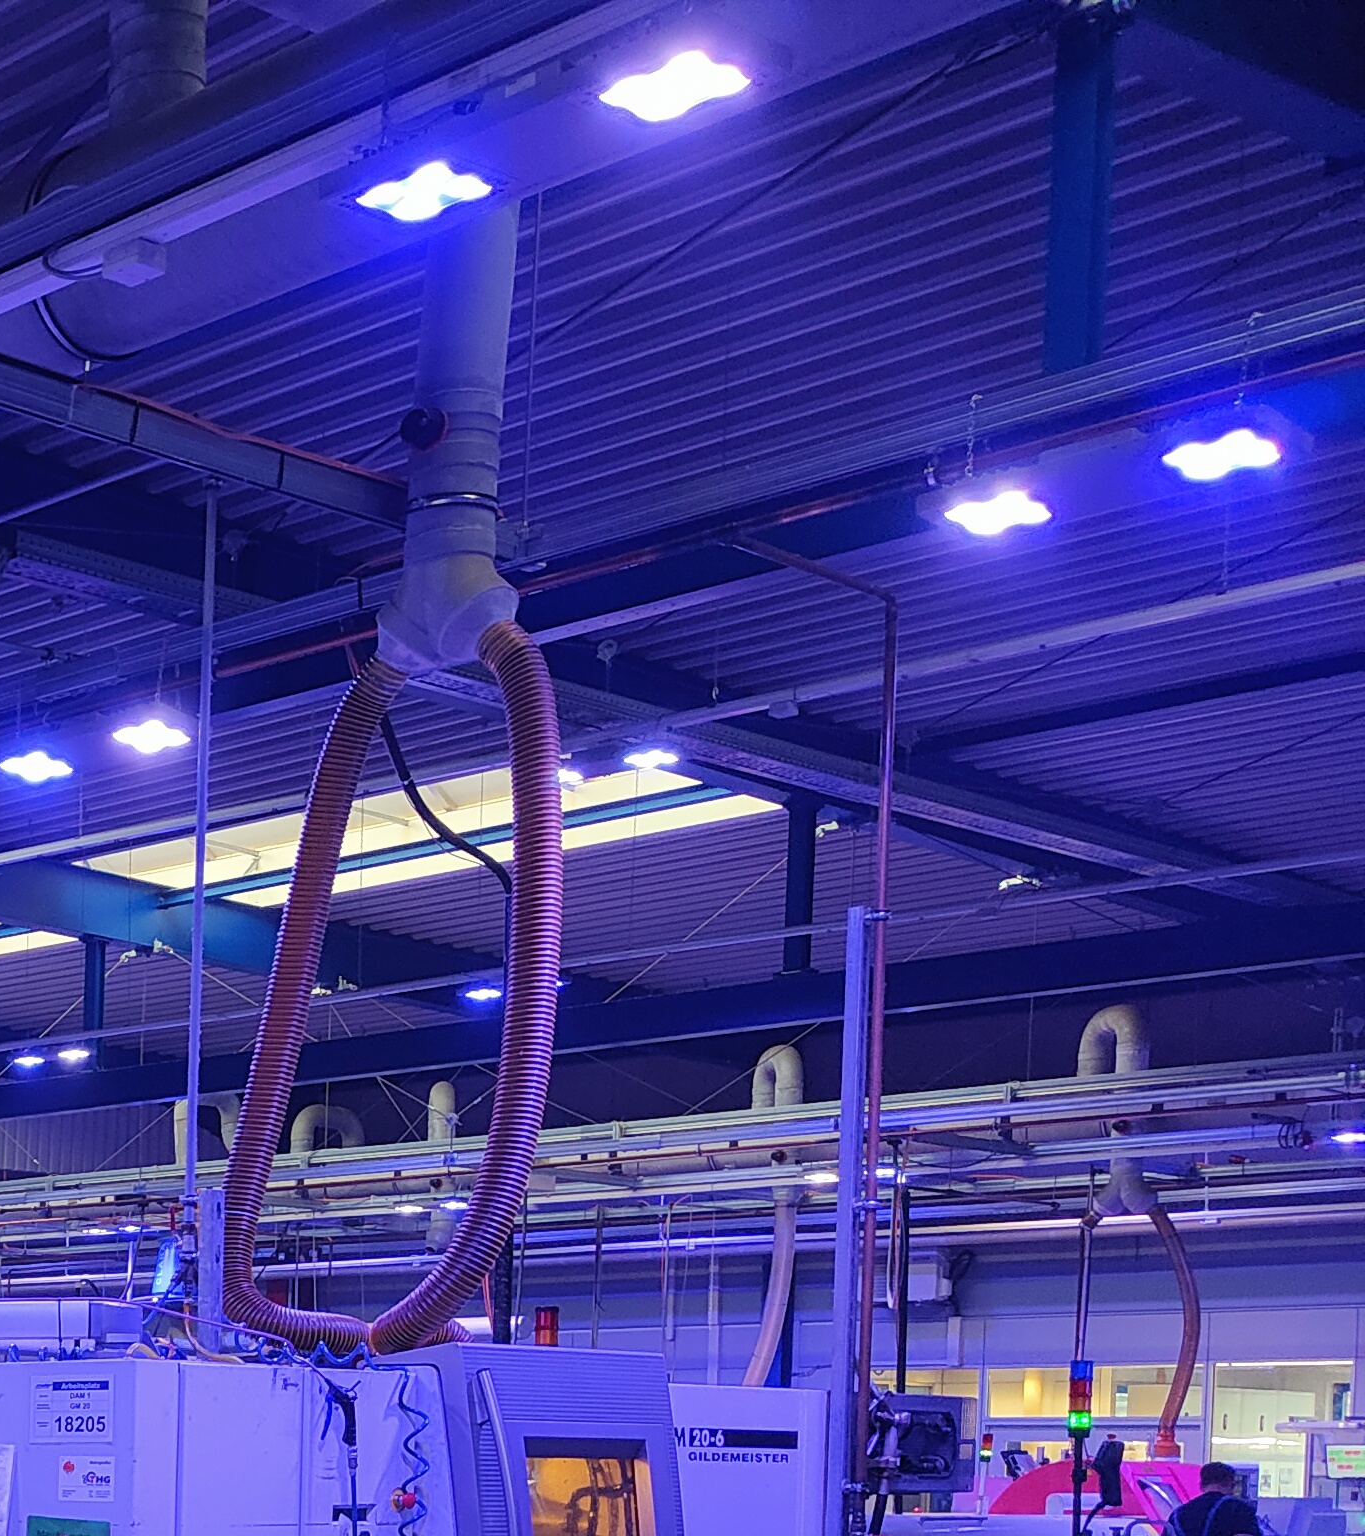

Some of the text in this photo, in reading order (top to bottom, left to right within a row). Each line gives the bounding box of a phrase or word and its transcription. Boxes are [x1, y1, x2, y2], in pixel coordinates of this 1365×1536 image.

[54, 1415, 106, 1433] 18205
[692, 1429, 725, 1447] 20-6
[688, 1451, 789, 1463] GILDEMEISTER
